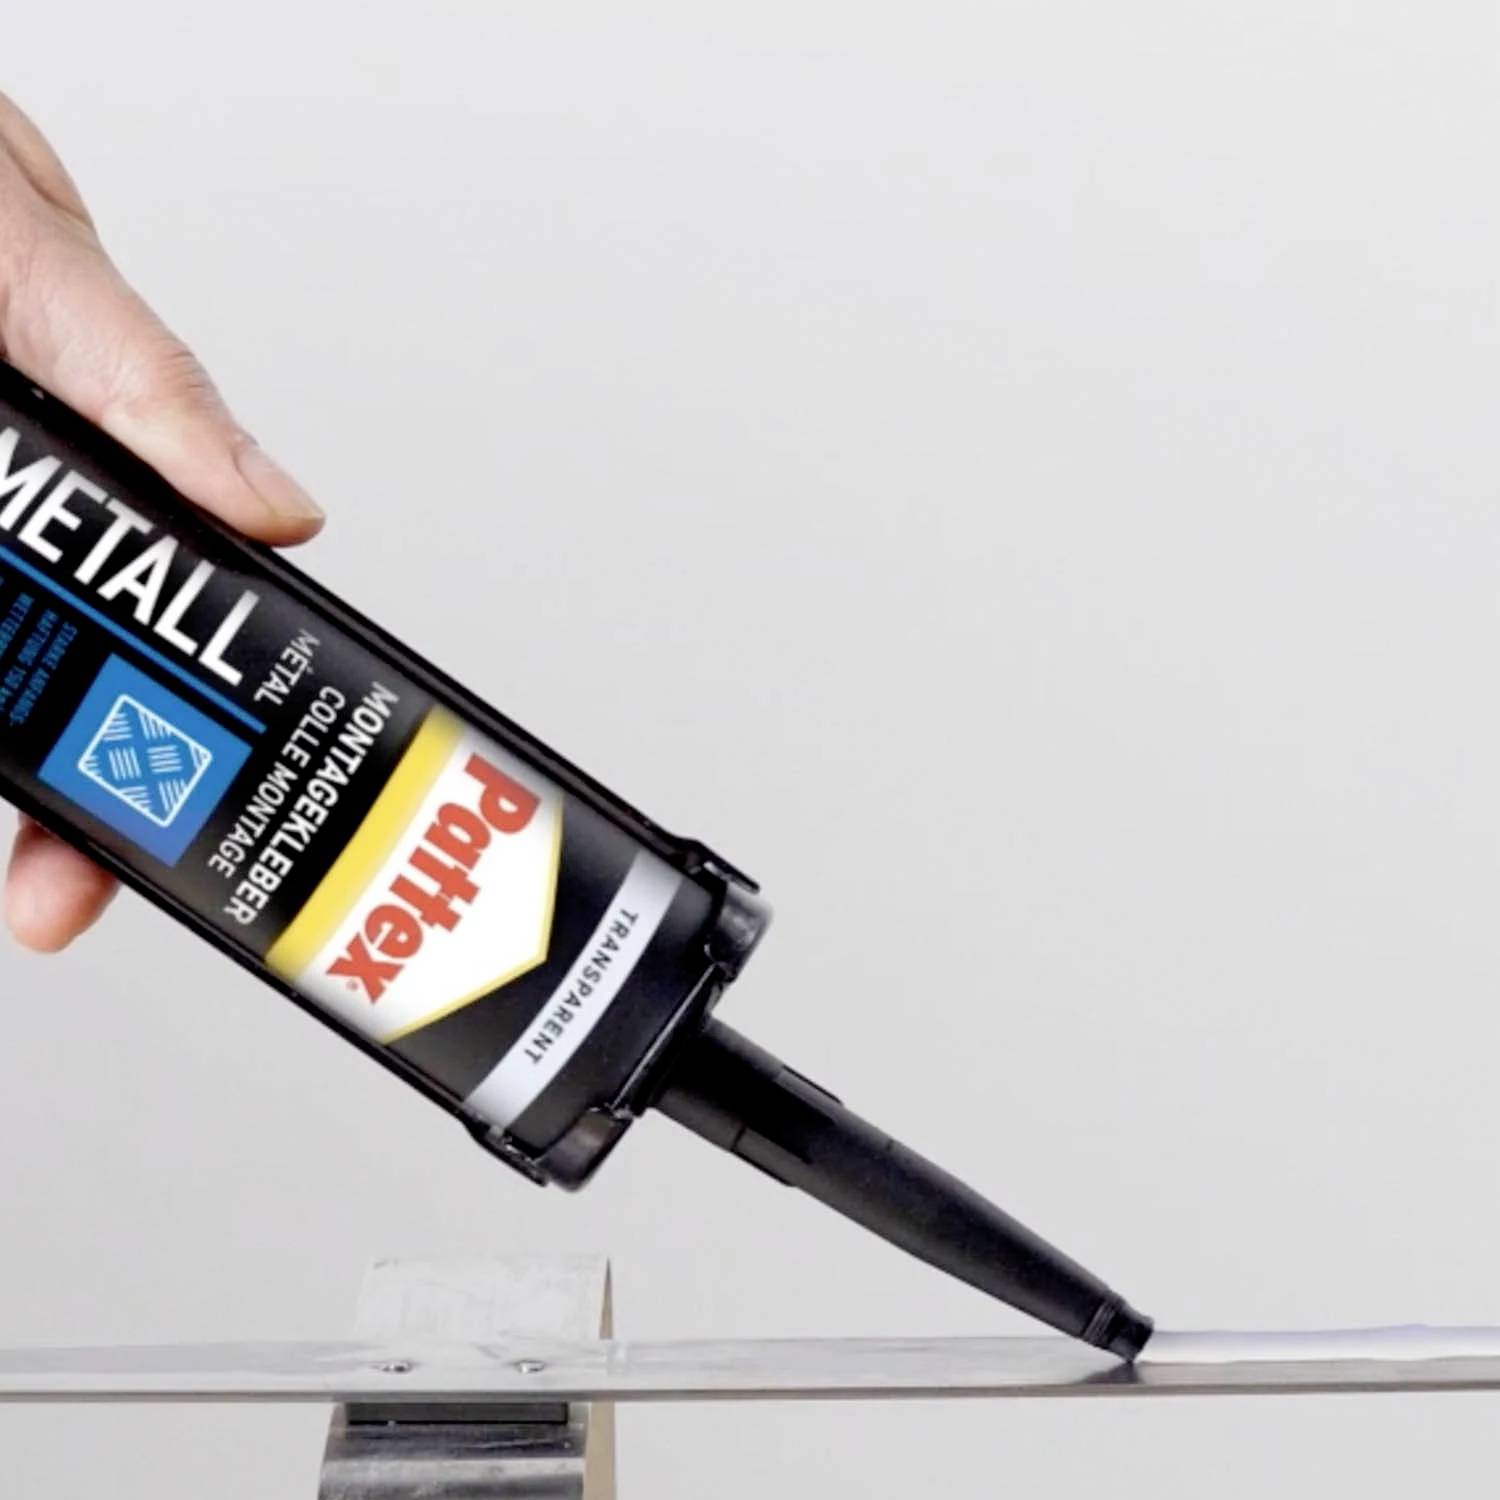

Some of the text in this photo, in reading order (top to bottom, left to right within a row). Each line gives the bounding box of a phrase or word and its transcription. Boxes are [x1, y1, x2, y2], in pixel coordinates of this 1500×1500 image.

[0, 426, 260, 686] METALL
[253, 628, 321, 706] MÉTAL
[208, 685, 346, 879] COLLE MONTAGE
[224, 681, 399, 925] MONTAGEKLEBER
[326, 752, 541, 1005] Pattex
[523, 909, 639, 1065] TRANSPARENT
